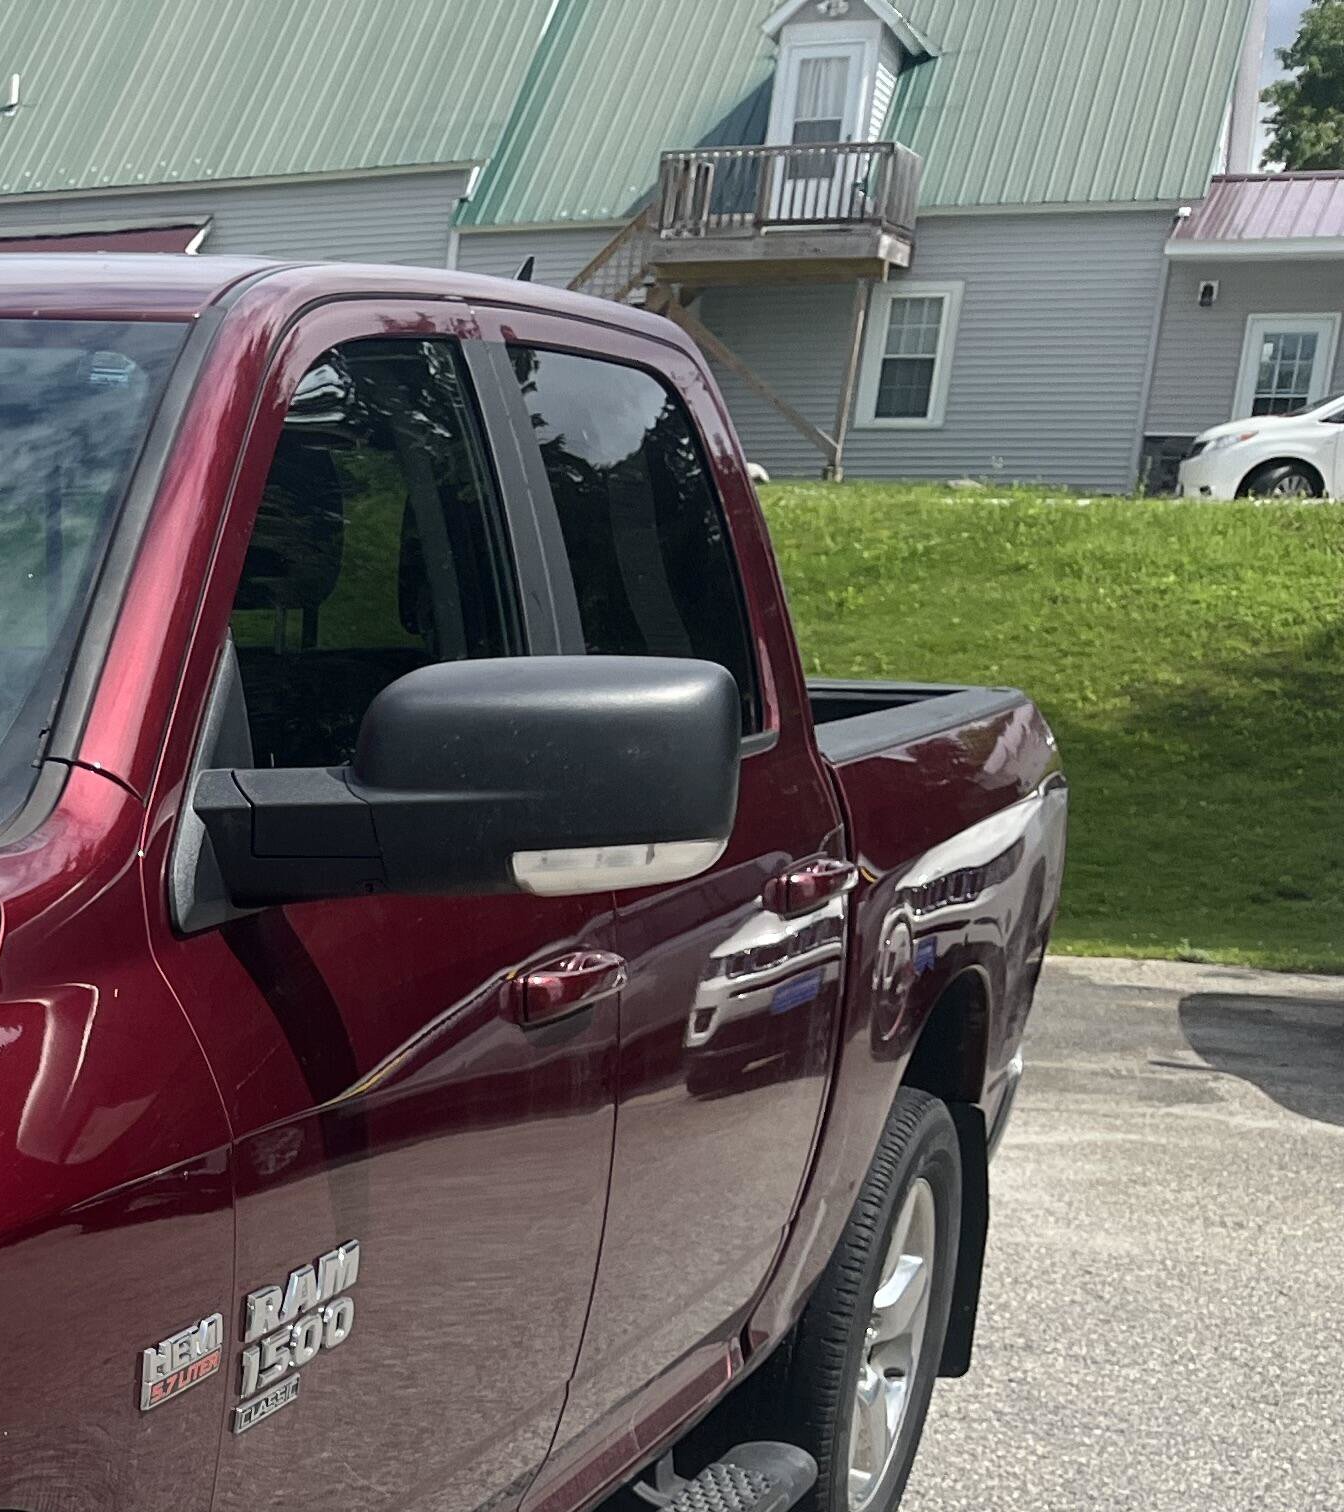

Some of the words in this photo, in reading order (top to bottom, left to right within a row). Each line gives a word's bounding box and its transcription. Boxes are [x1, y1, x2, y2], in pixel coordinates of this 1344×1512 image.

[244, 1238, 361, 1343] RAM
[143, 1312, 224, 1383] HEMI
[240, 1296, 356, 1400] 1500
[240, 1379, 299, 1432] CLASSIC
